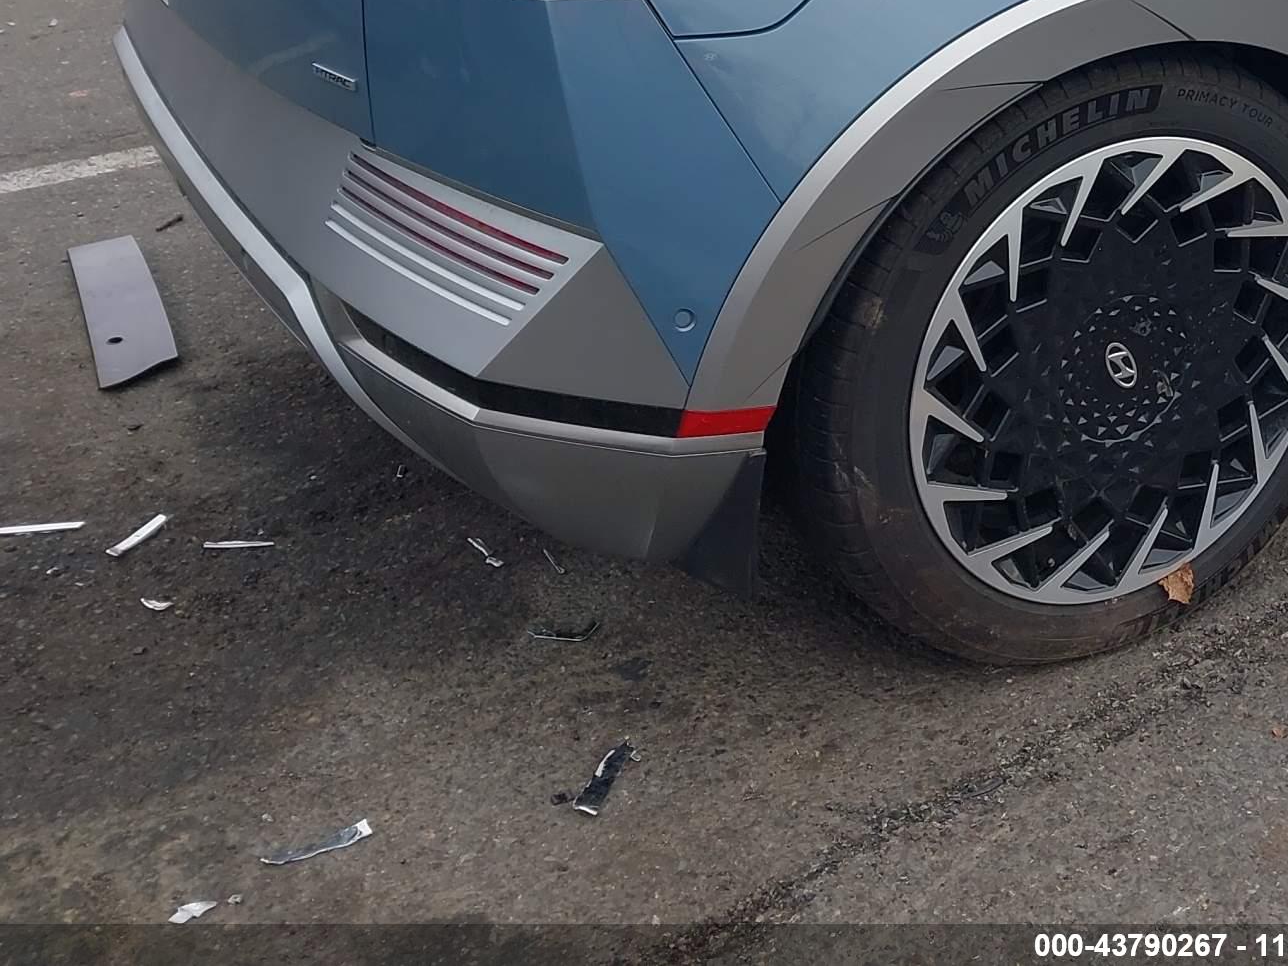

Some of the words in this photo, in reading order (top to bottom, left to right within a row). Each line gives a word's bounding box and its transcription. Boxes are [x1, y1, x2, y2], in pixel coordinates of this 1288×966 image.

[963, 88, 1150, 207] MICHELIN
[1177, 88, 1237, 109] PRIMACY
[1241, 103, 1273, 128] TOUR
